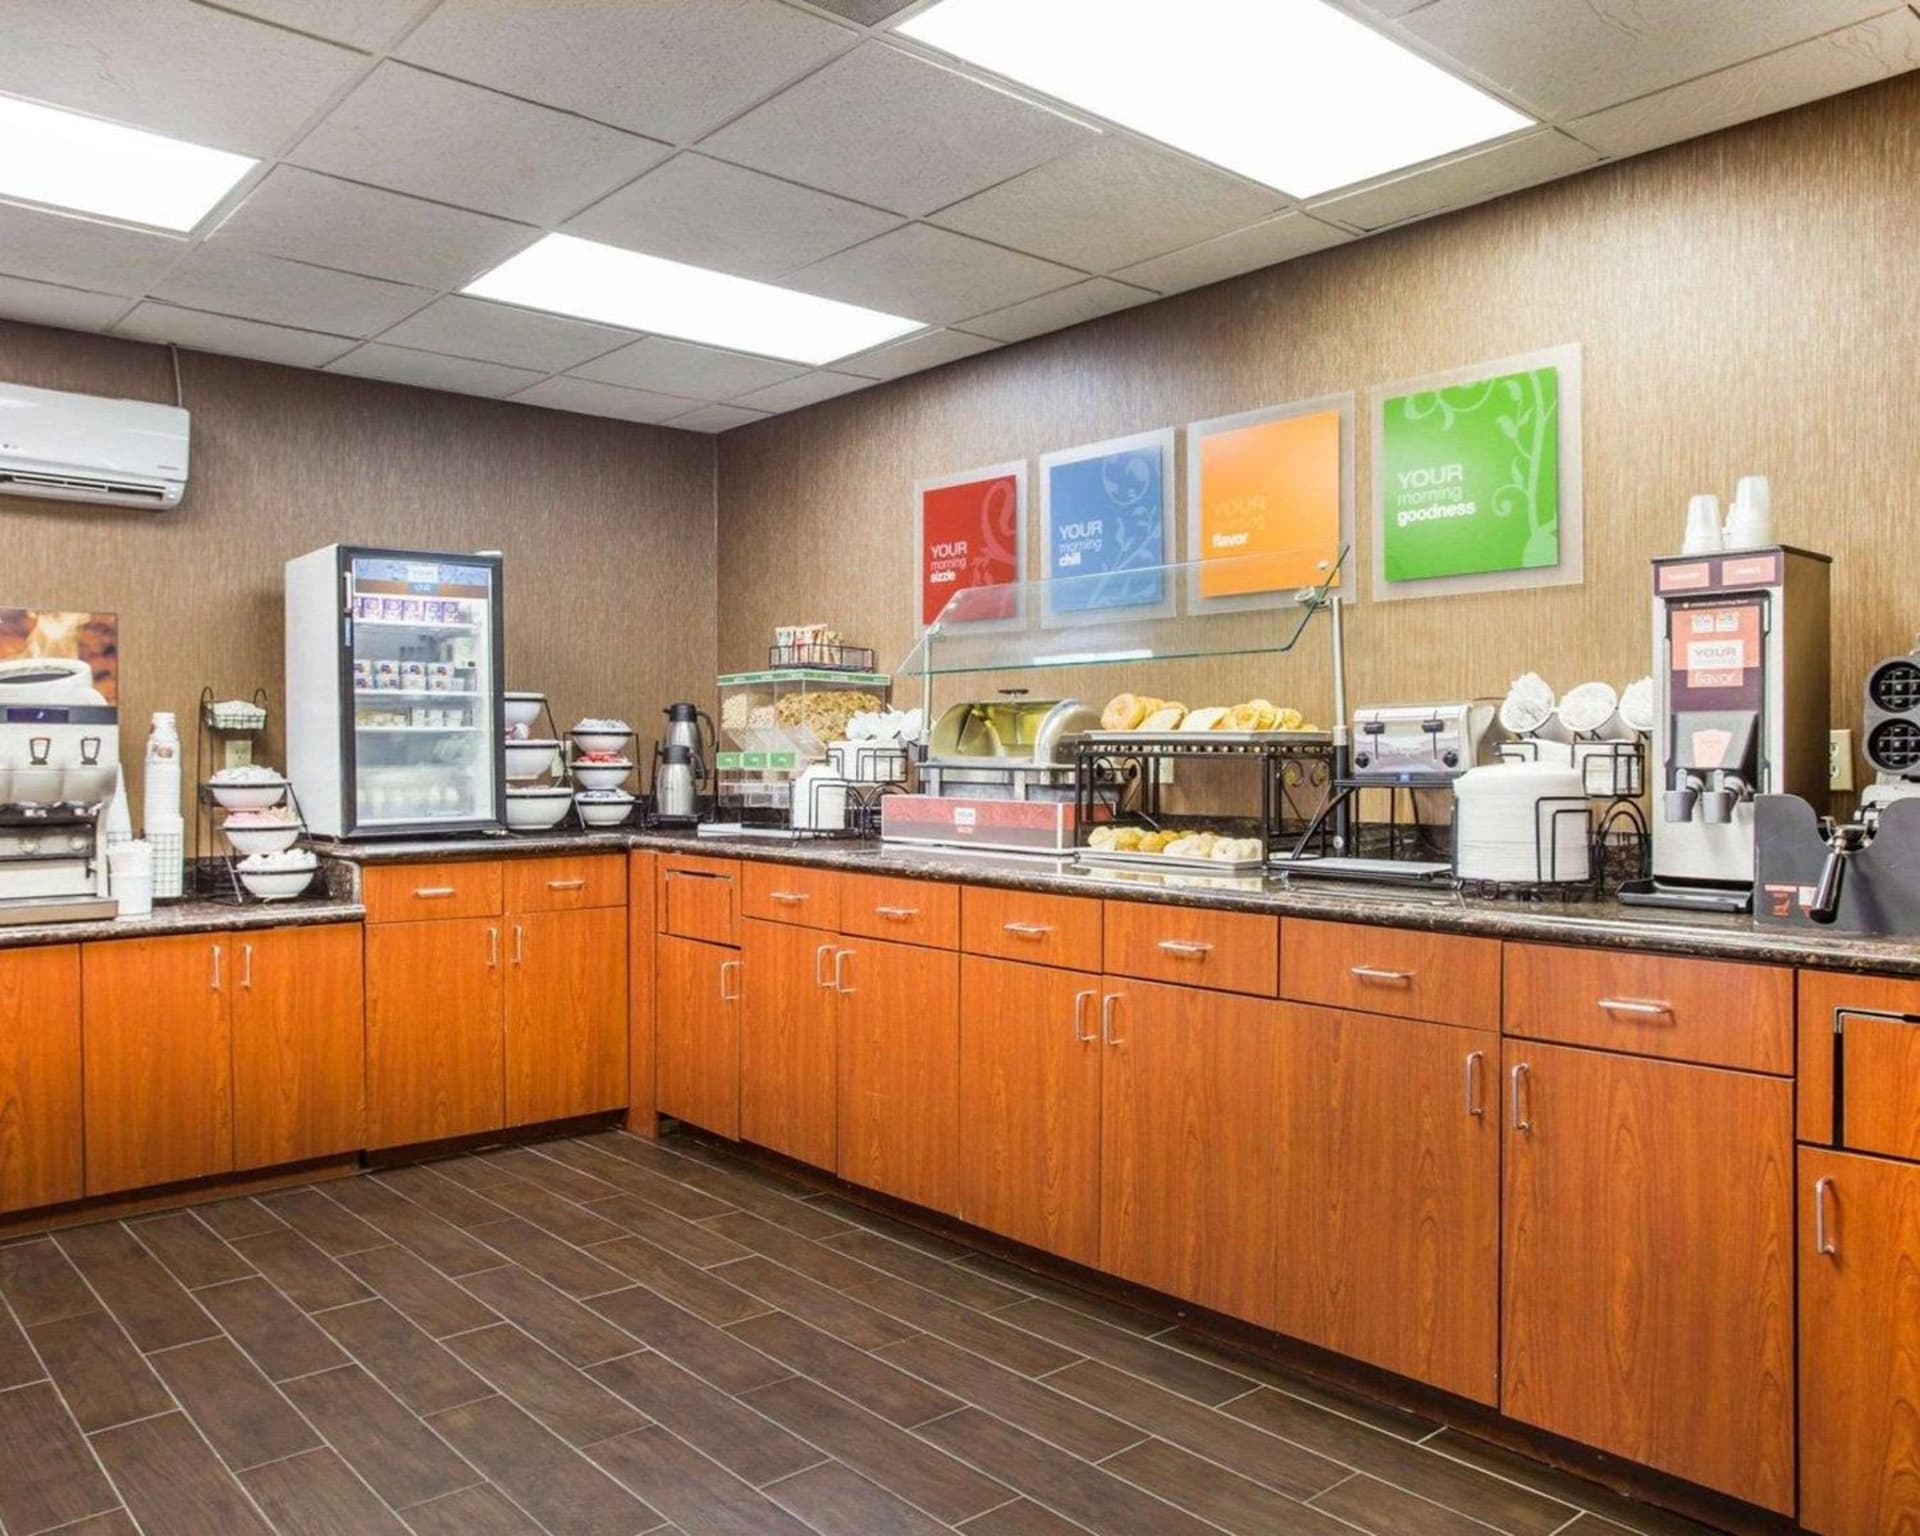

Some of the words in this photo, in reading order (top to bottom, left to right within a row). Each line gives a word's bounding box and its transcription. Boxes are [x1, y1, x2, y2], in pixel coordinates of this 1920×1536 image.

[1397, 464, 1463, 489] YOUR
[1397, 486, 1463, 507] morning
[1398, 501, 1476, 527] goodness
[1059, 520, 1103, 540] YOUR
[1059, 539, 1102, 553] morning
[1211, 531, 1249, 549] flavor
[930, 540, 968, 559] YOUR
[930, 558, 967, 571] morning
[1058, 552, 1081, 567] chill
[1694, 646, 1737, 659] YOUR
